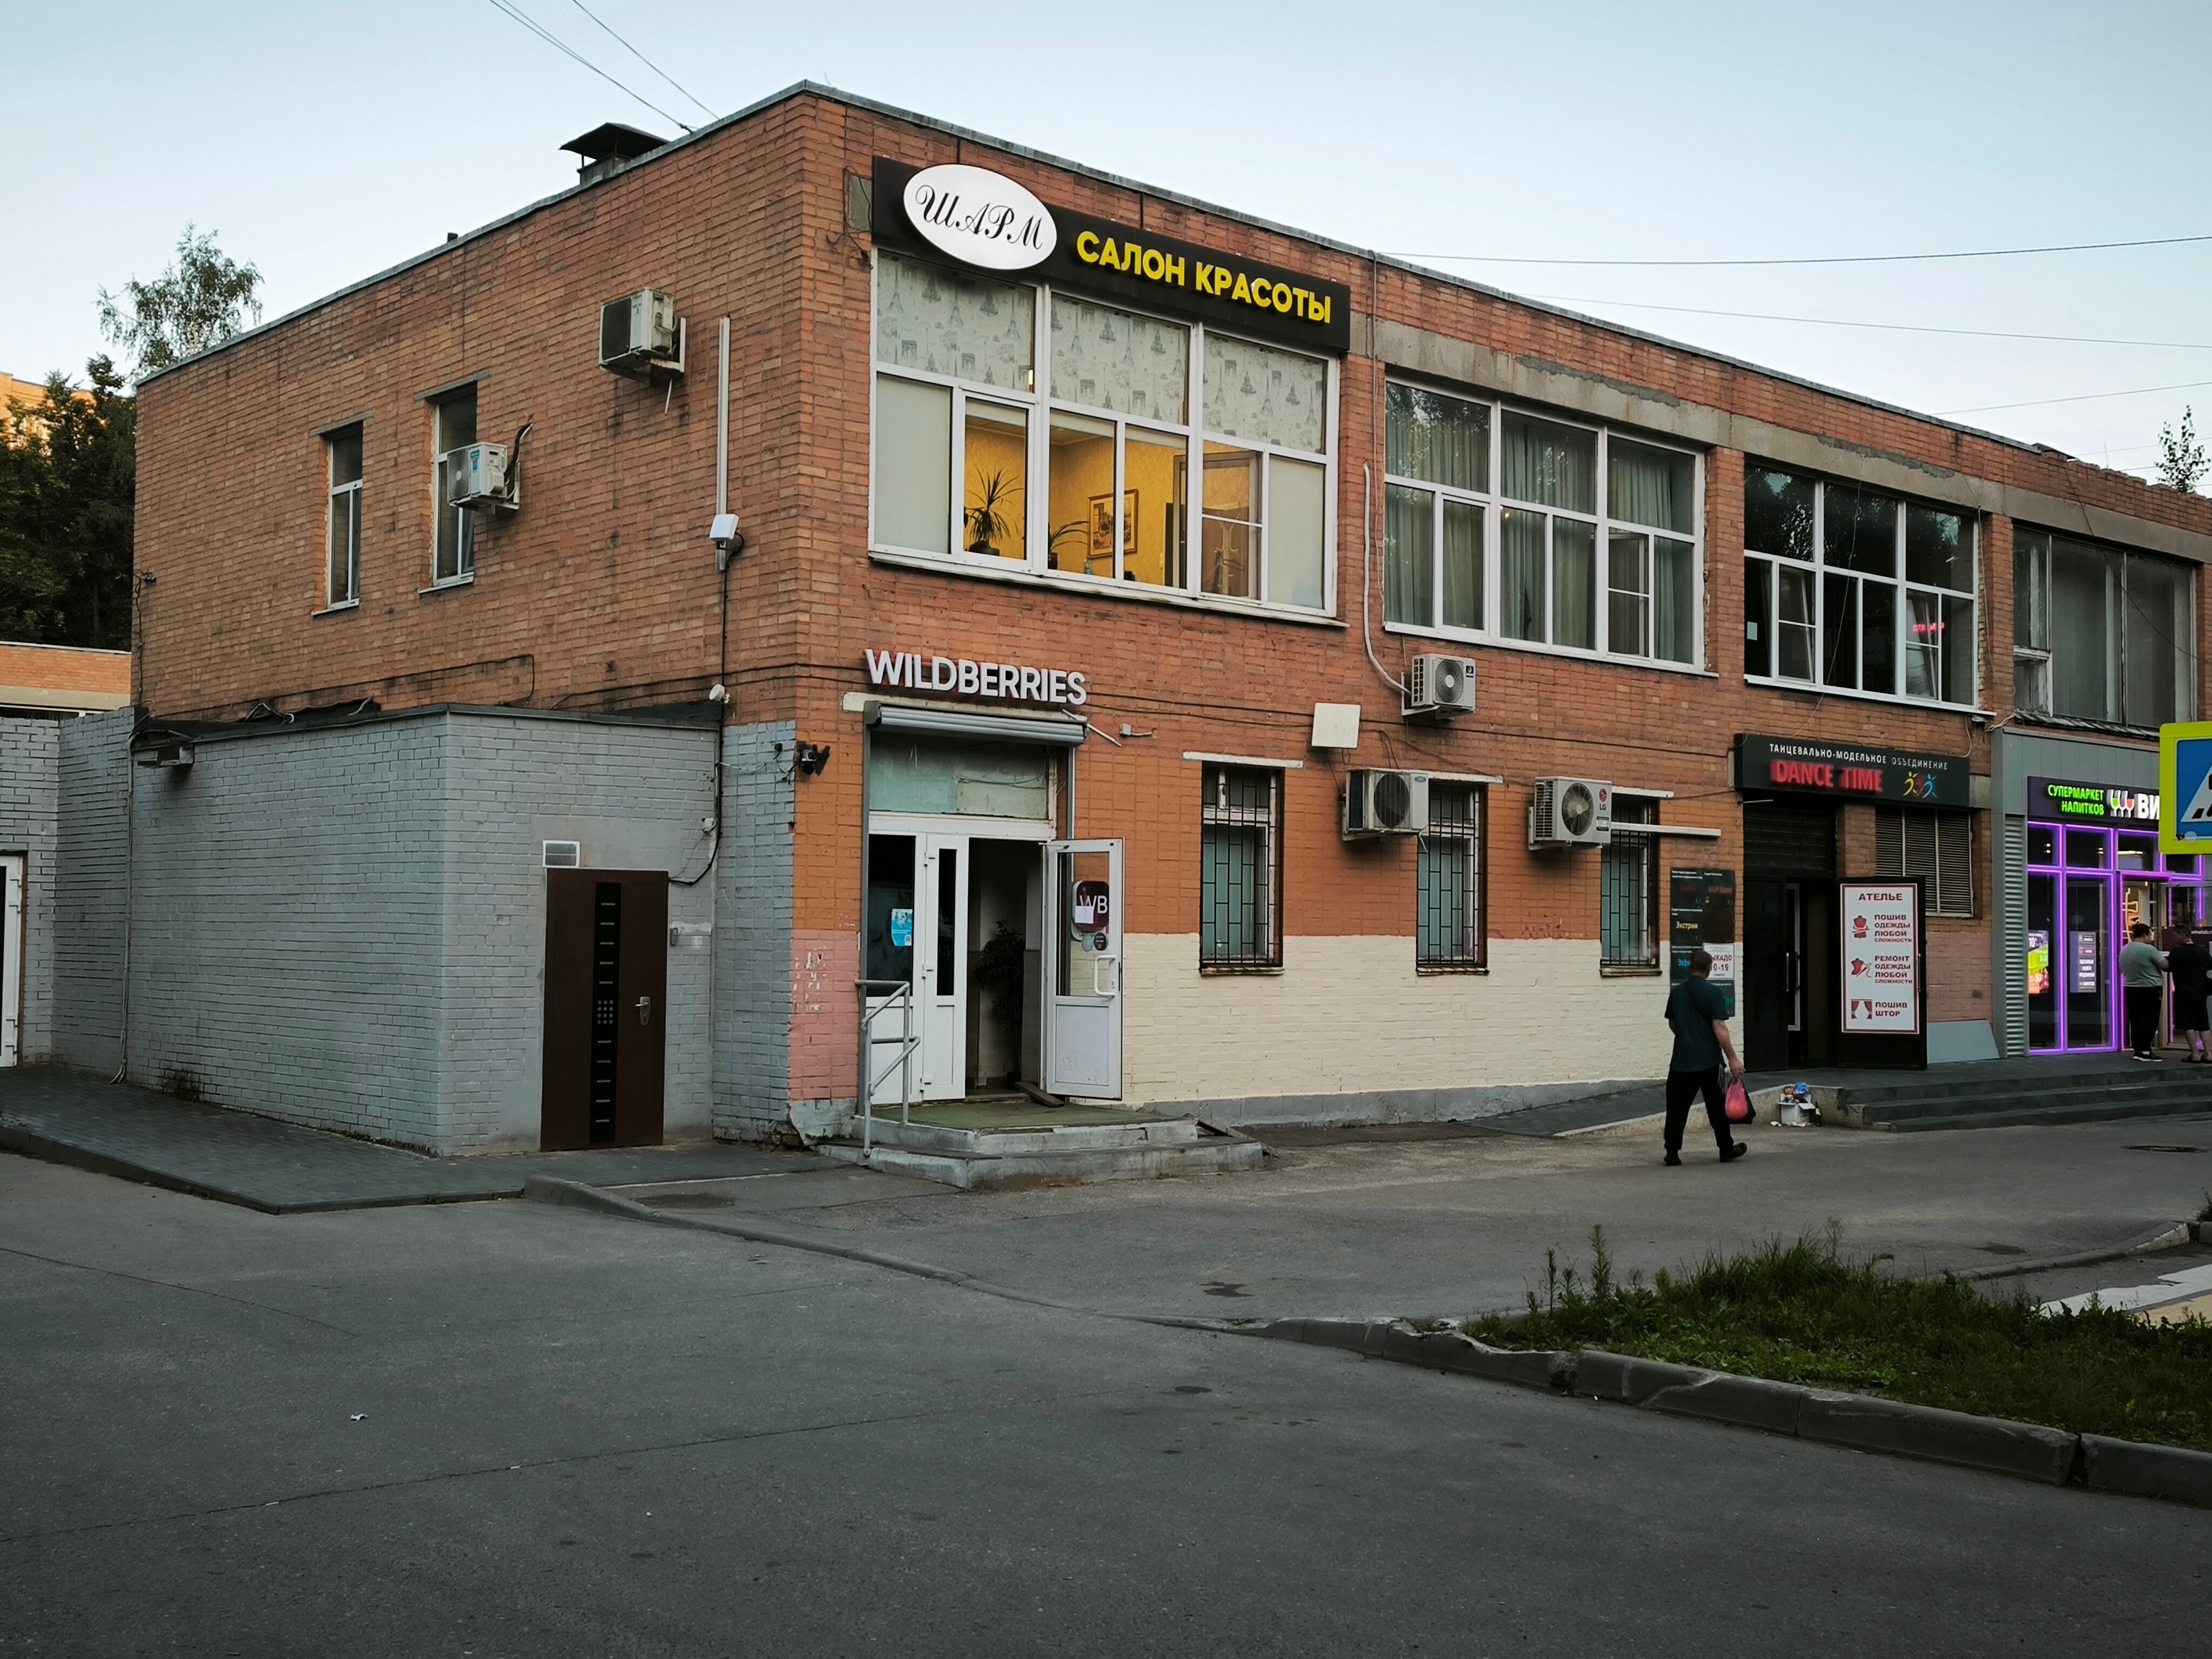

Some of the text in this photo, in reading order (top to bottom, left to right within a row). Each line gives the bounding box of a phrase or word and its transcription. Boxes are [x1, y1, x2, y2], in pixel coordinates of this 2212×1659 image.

[915, 184, 1044, 250] ШАРМ
[1076, 230, 1331, 325] САЛОН КРАСОТЫ
[865, 649, 1088, 705] WILDBERRIES
[1769, 743, 1948, 770] ТАНЦЕВАЛЬНО-МОДЕЛЬНОЕ ОБЪЕДИНЕНИЕ
[1770, 760, 1883, 793] DANCE TIME
[2047, 785, 2104, 801] СУПЕРМАРКЕТ
[2061, 800, 2105, 815] НАПИТКОВ
[1080, 895, 1108, 914] WB
